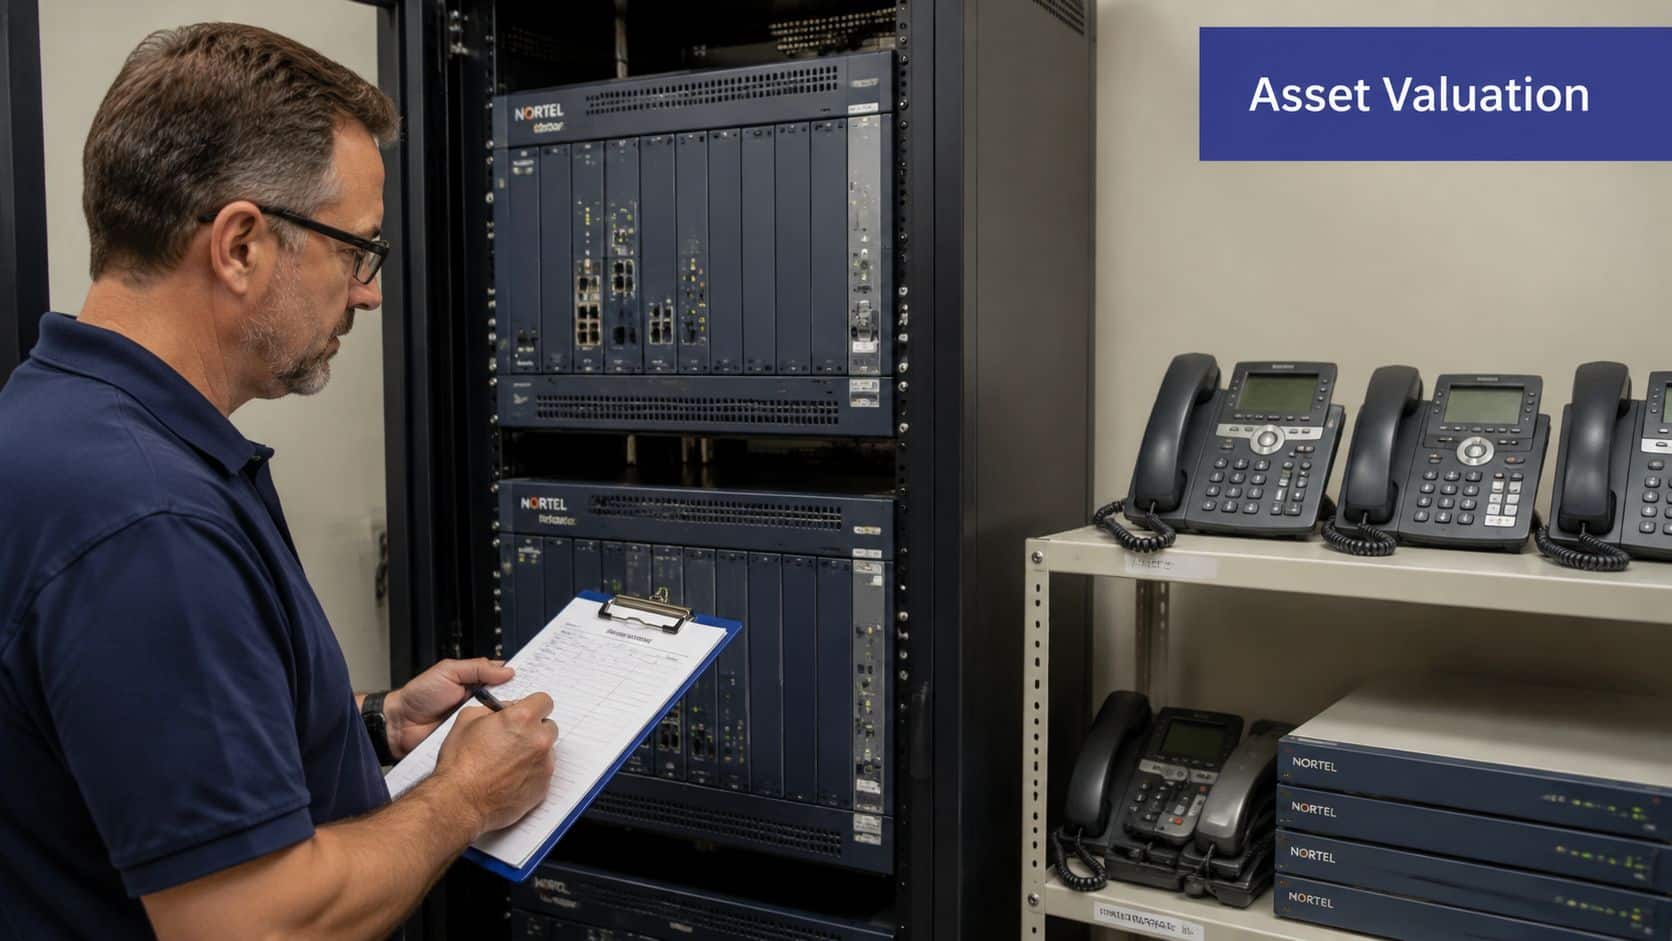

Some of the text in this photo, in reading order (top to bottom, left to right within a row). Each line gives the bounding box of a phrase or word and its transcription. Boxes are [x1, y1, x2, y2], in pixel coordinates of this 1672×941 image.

[514, 103, 565, 122] NORTEL
[520, 495, 568, 511] NORTEL
[1292, 756, 1337, 773] NORTEL
[1291, 801, 1337, 818] NORTEL
[1290, 846, 1336, 864] NORTEL
[1288, 891, 1334, 909] NORTEL
